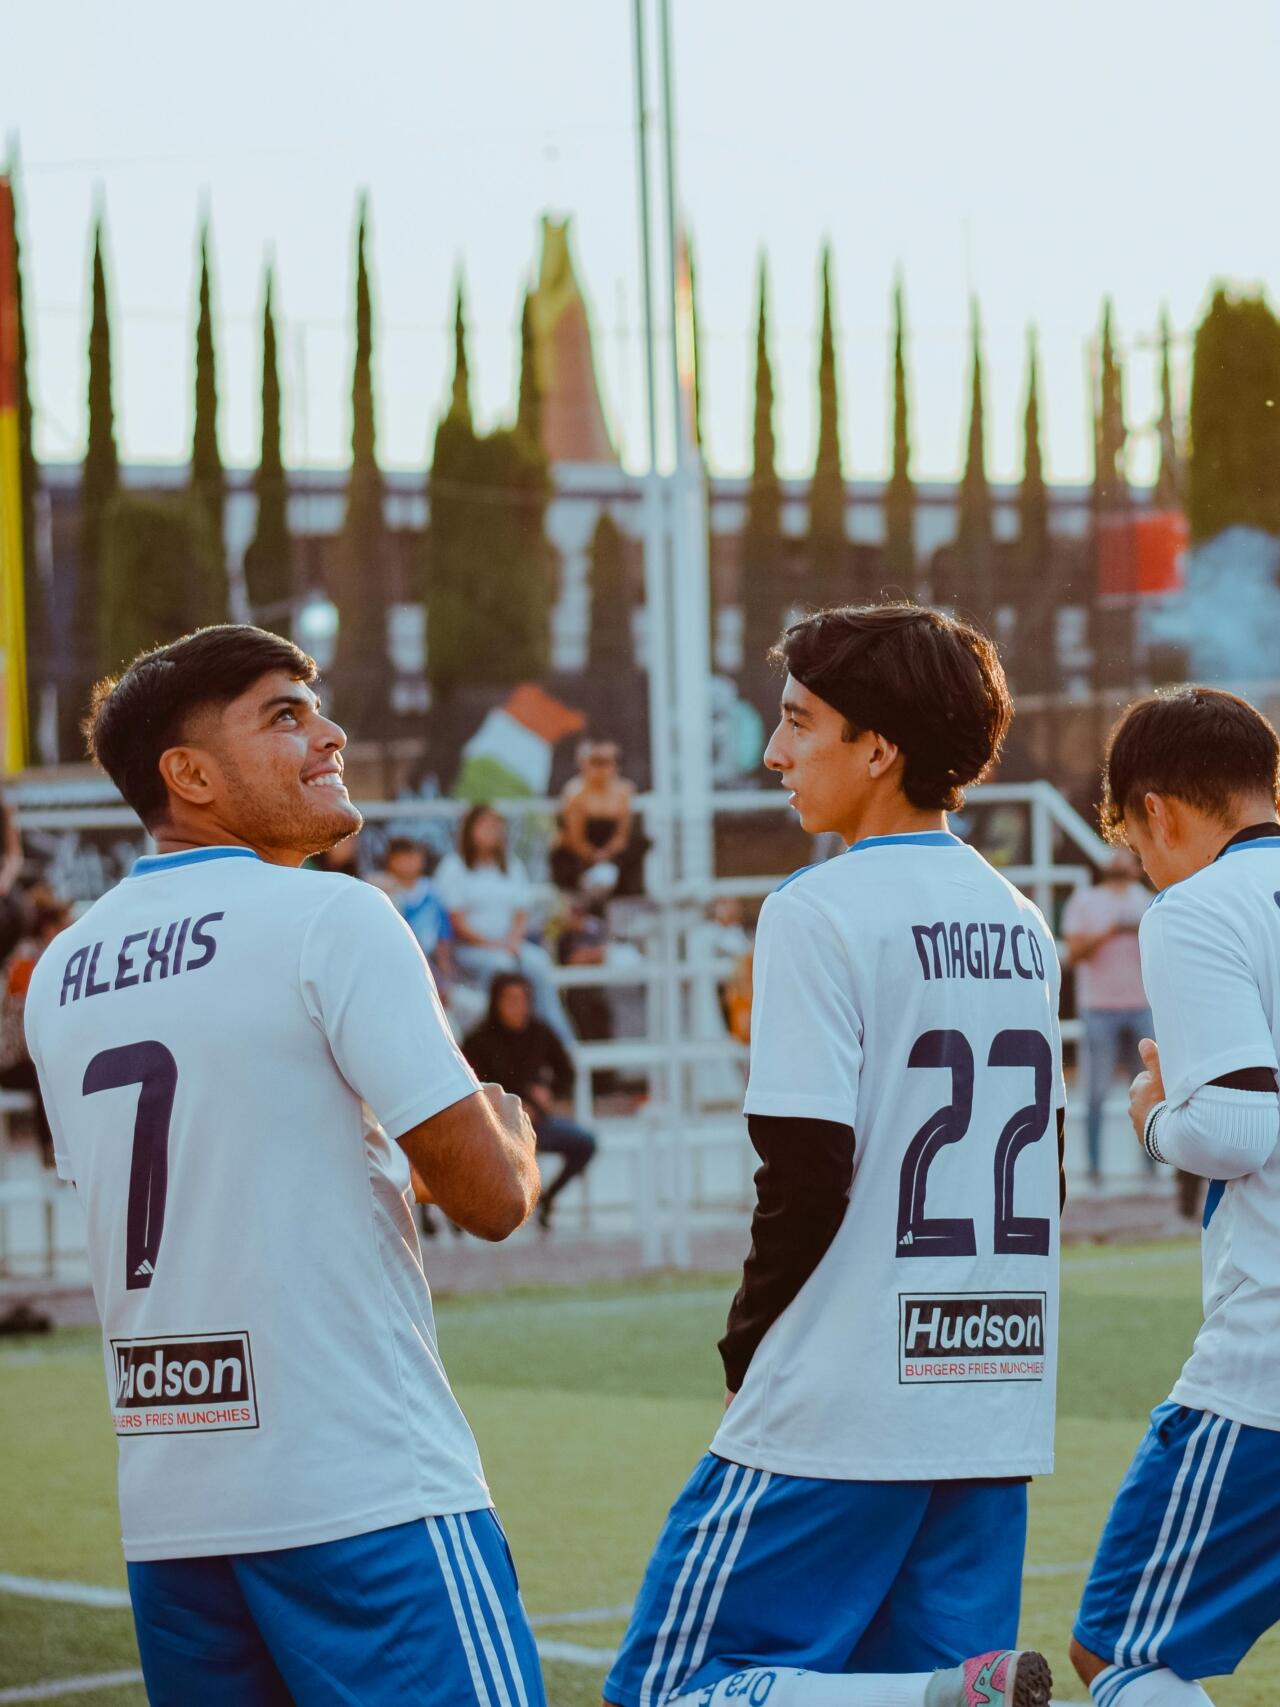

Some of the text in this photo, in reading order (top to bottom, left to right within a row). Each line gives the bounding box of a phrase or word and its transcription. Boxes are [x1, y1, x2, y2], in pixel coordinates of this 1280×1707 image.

[59, 911, 225, 1007] ALEXIS
[911, 921, 1044, 981] MAGIZCO
[82, 1040, 178, 1290] 7
[895, 1029, 1053, 1257] 22
[905, 1304, 1042, 1350] Hudson
[905, 1363, 966, 1376] BURGERS
[968, 1362, 998, 1375] FRIES
[145, 1412, 174, 1427] FRIES
[176, 1408, 250, 1425] MUNCHIES
